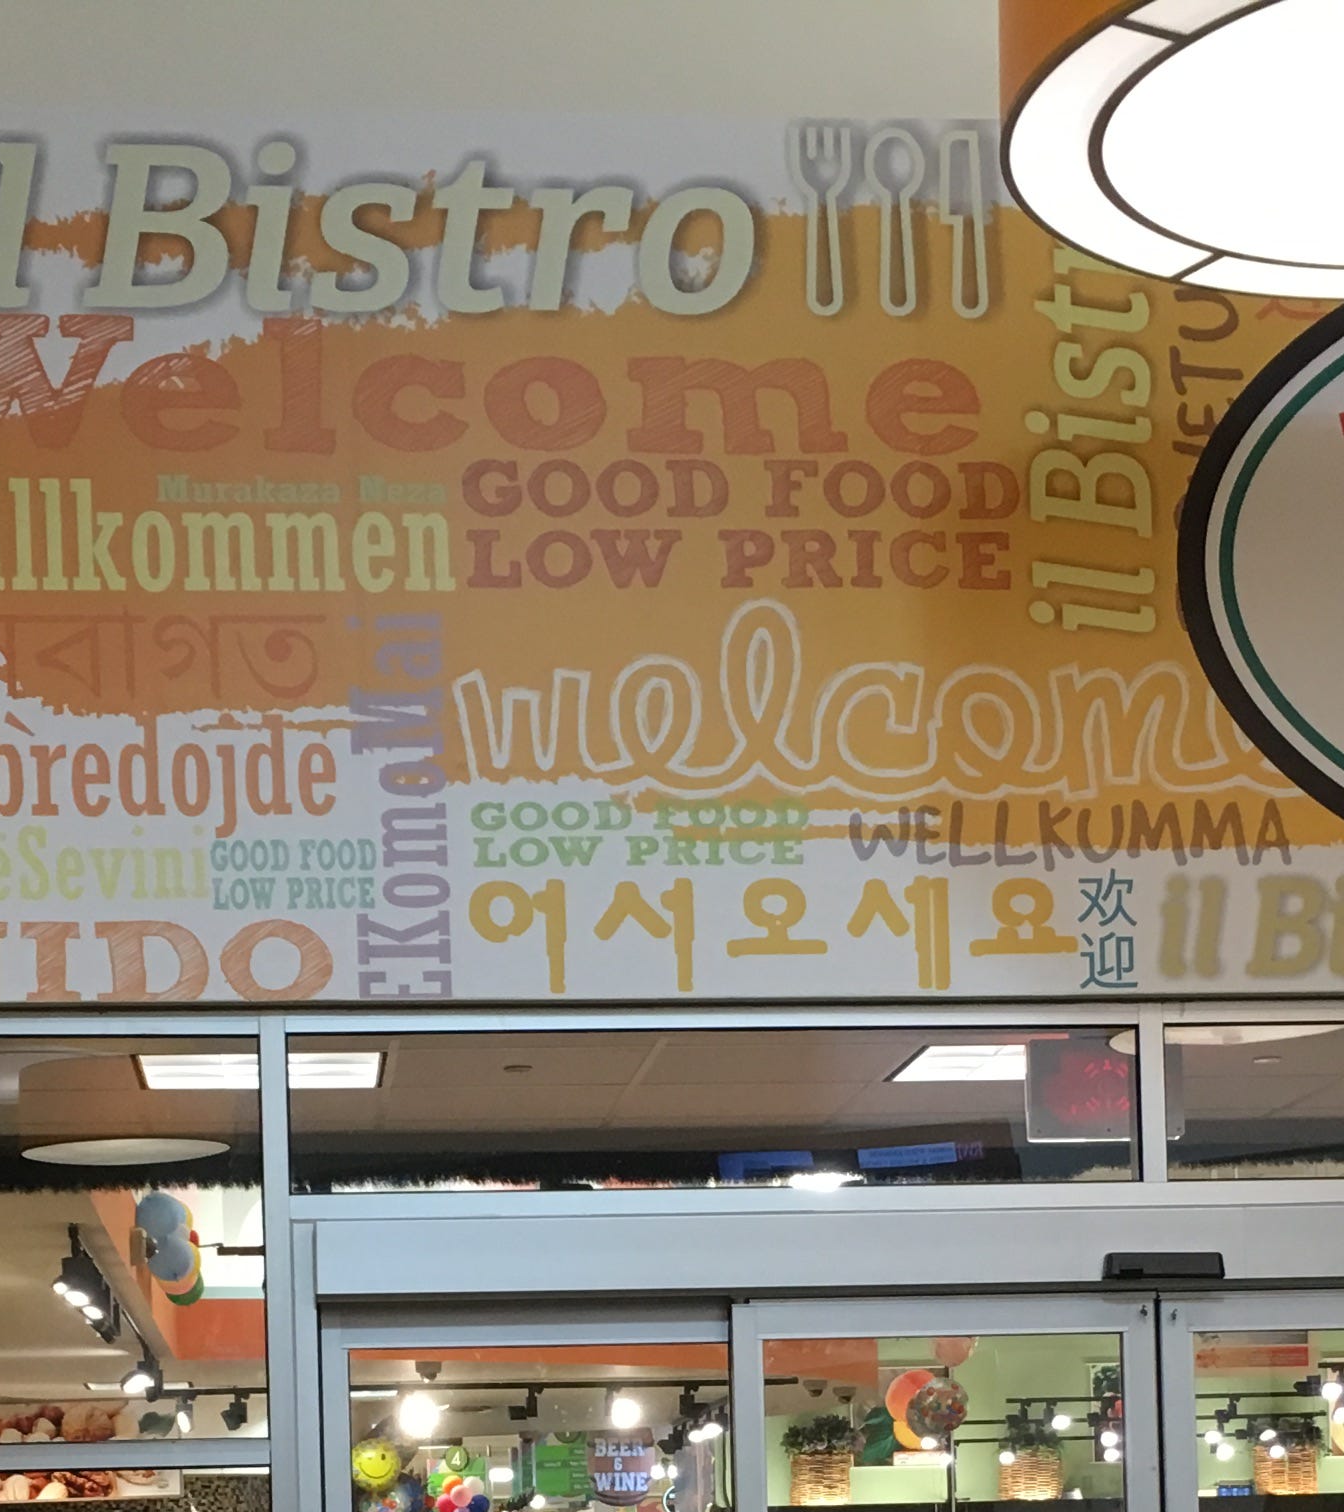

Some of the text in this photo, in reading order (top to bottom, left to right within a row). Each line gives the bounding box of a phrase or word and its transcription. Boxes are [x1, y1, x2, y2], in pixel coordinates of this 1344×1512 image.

[81, 139, 757, 316] Bistro
[156, 472, 448, 504] Murakaza Neza
[462, 458, 1021, 520] GOOD FOOD
[466, 529, 1012, 590] LOW PRICE
[470, 799, 809, 831] GOOD FOOD
[473, 835, 806, 868] LOW PRICE
[850, 799, 1293, 871] WELLKUMMA
[211, 838, 376, 871] GOOD FOOD
[212, 877, 376, 910] LOW PRICE
[468, 876, 1079, 993] 어서오세요
[1078, 868, 1139, 989] 欢迎
[1159, 873, 1226, 979] il
[451, 1453, 460, 1465] 4
[594, 1440, 645, 1457] BEER
[593, 1472, 649, 1492] WINE
